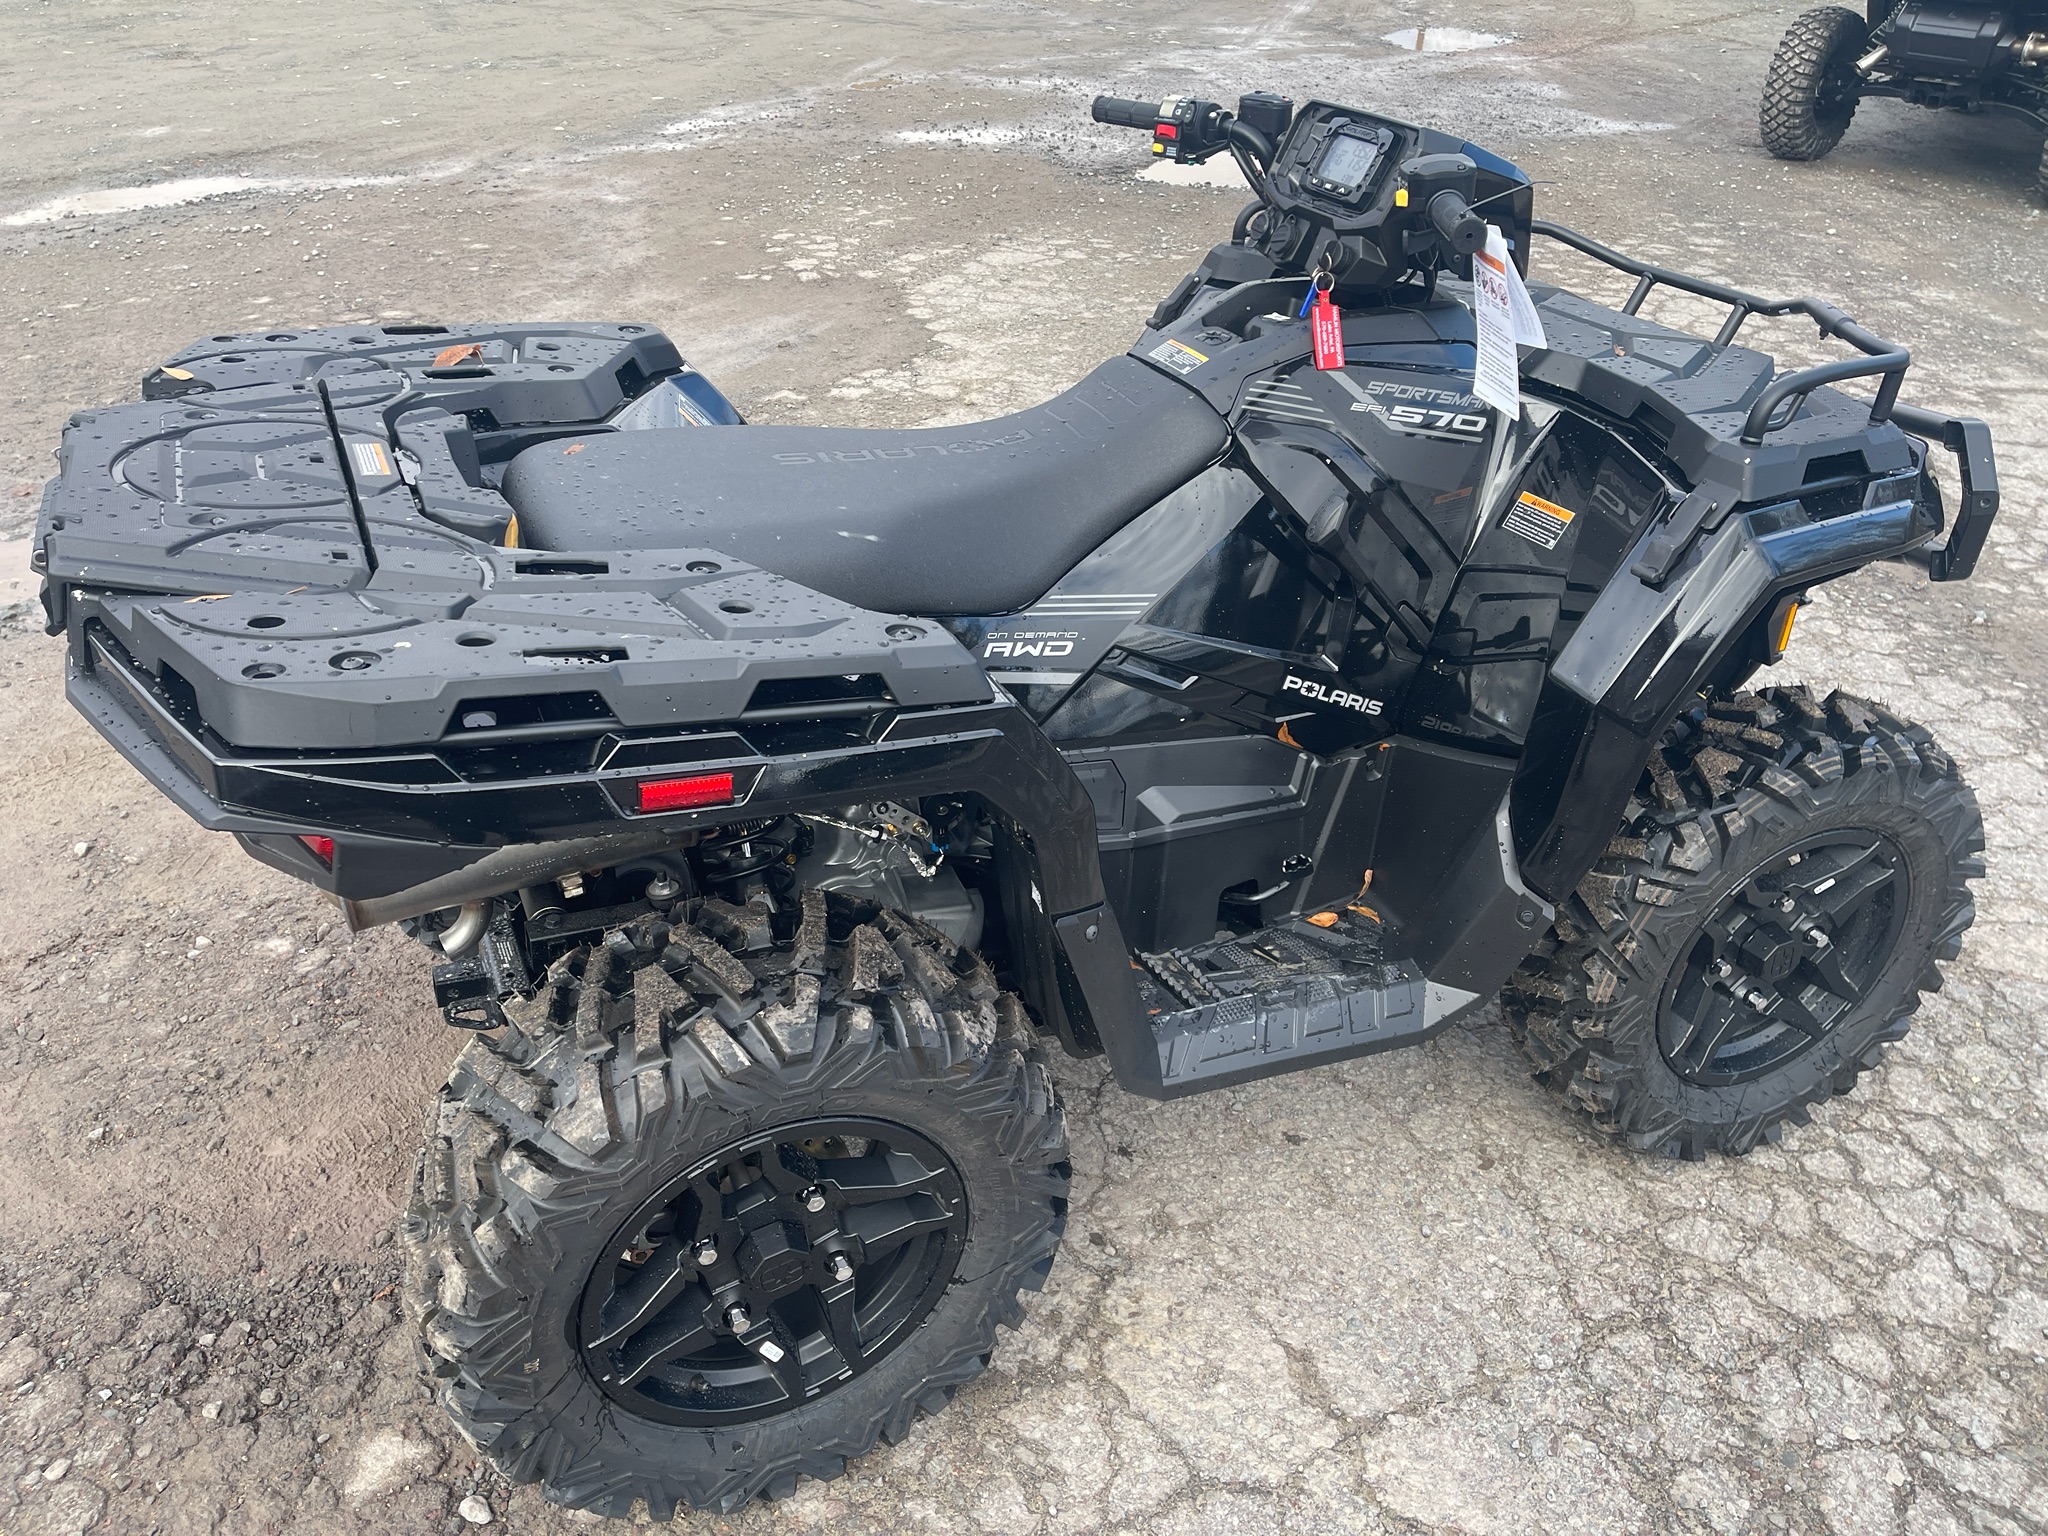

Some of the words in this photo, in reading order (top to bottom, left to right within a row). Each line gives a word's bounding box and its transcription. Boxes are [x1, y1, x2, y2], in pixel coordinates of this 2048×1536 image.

[1334, 328, 1343, 367] MOTORSPORTS
[1350, 402, 1387, 415] EFI
[1388, 405, 1487, 432] 570
[1535, 501, 1561, 516] WARNING
[983, 641, 1074, 658] AWD
[1282, 674, 1384, 716] POLARIS
